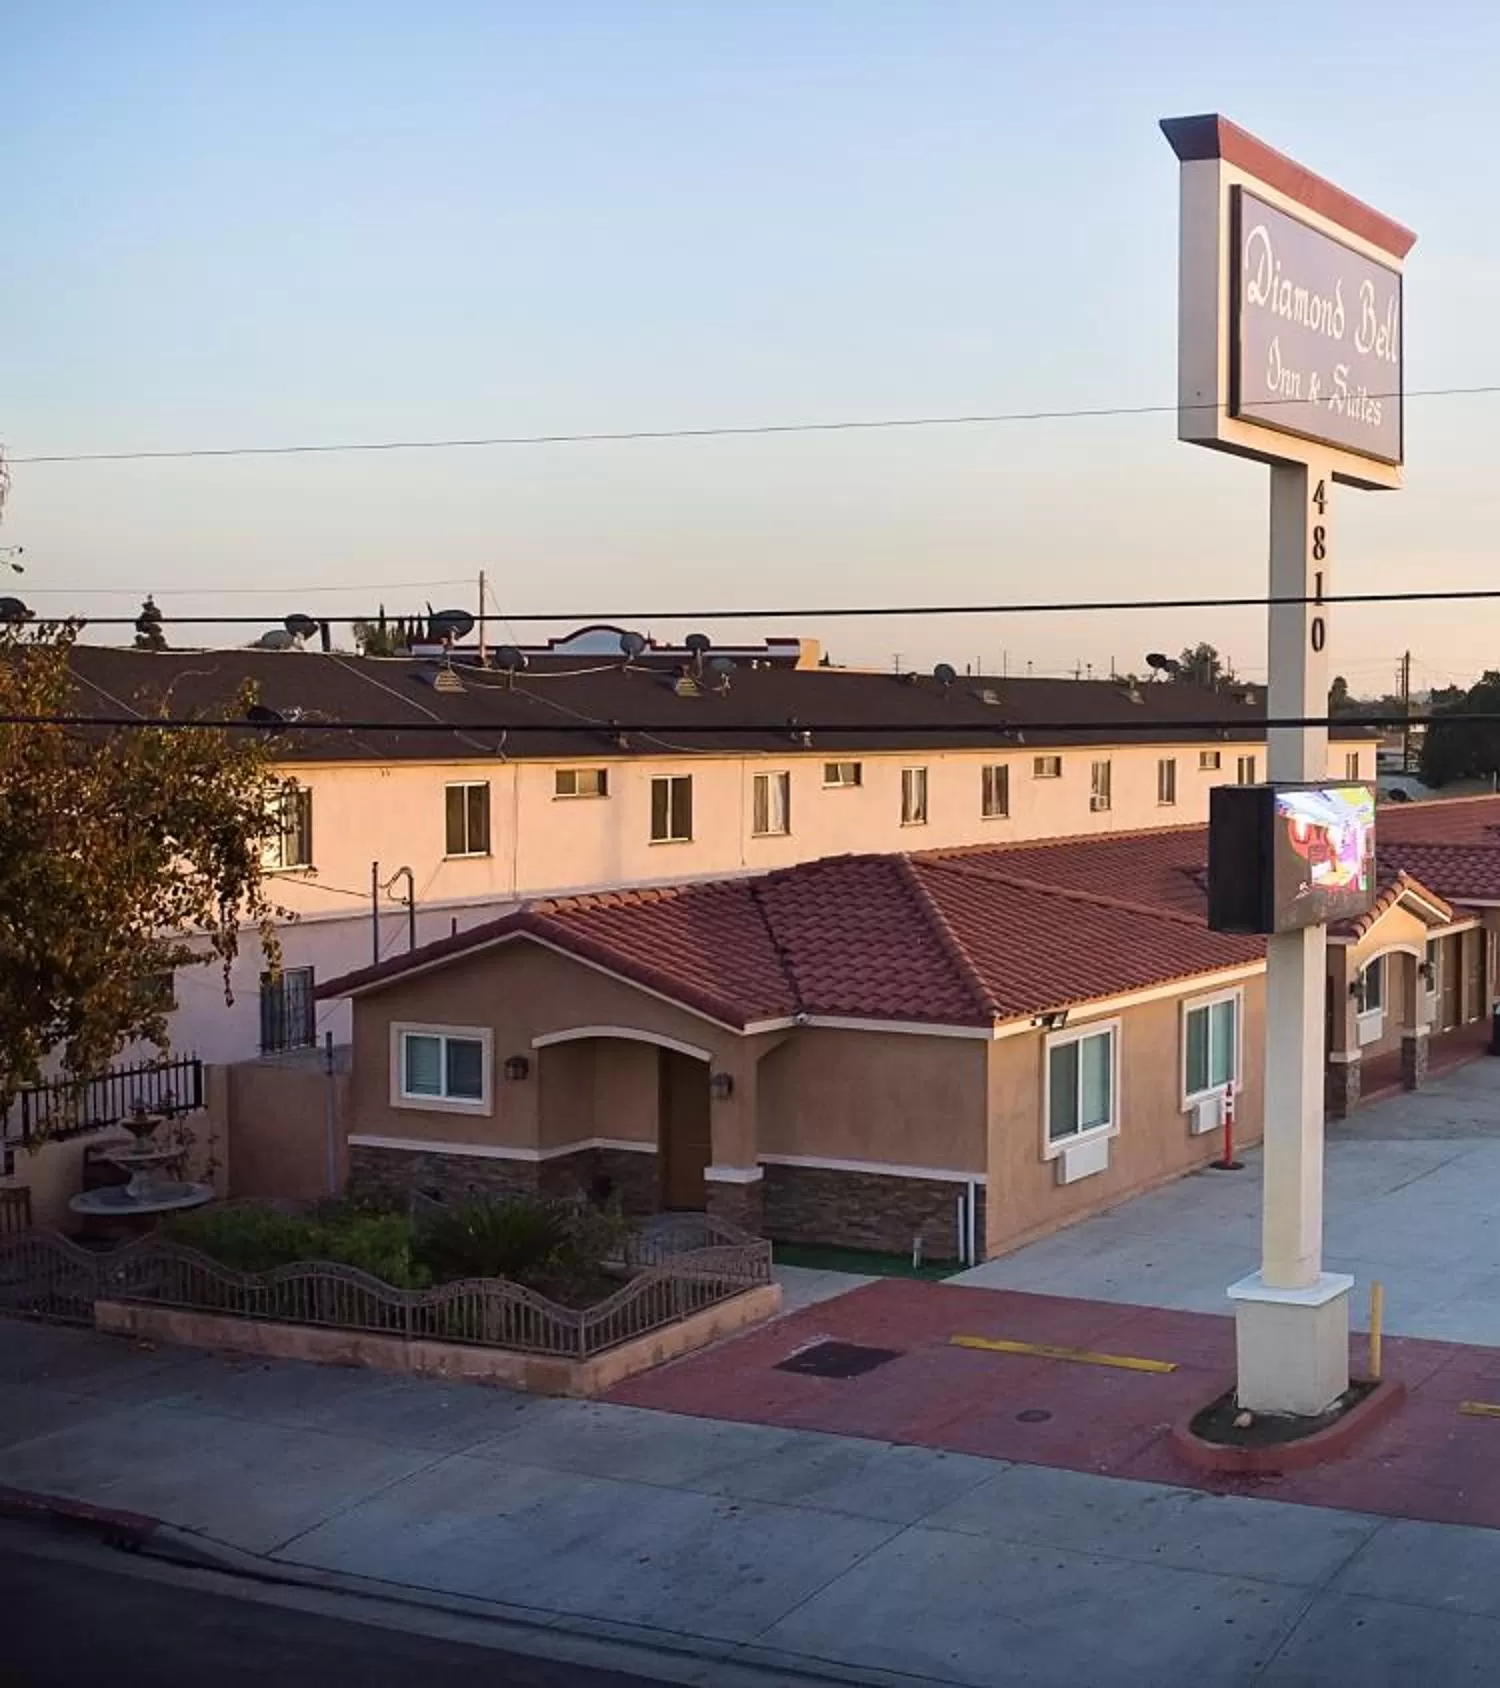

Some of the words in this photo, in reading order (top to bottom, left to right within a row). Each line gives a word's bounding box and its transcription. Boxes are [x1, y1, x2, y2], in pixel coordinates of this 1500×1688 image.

[1246, 226, 1344, 339] Diamond
[1355, 279, 1400, 363] Bell
[1267, 336, 1301, 397] Inn
[1308, 371, 1321, 405] &
[1328, 363, 1382, 425] Suites
[1312, 479, 1327, 652] 4810
